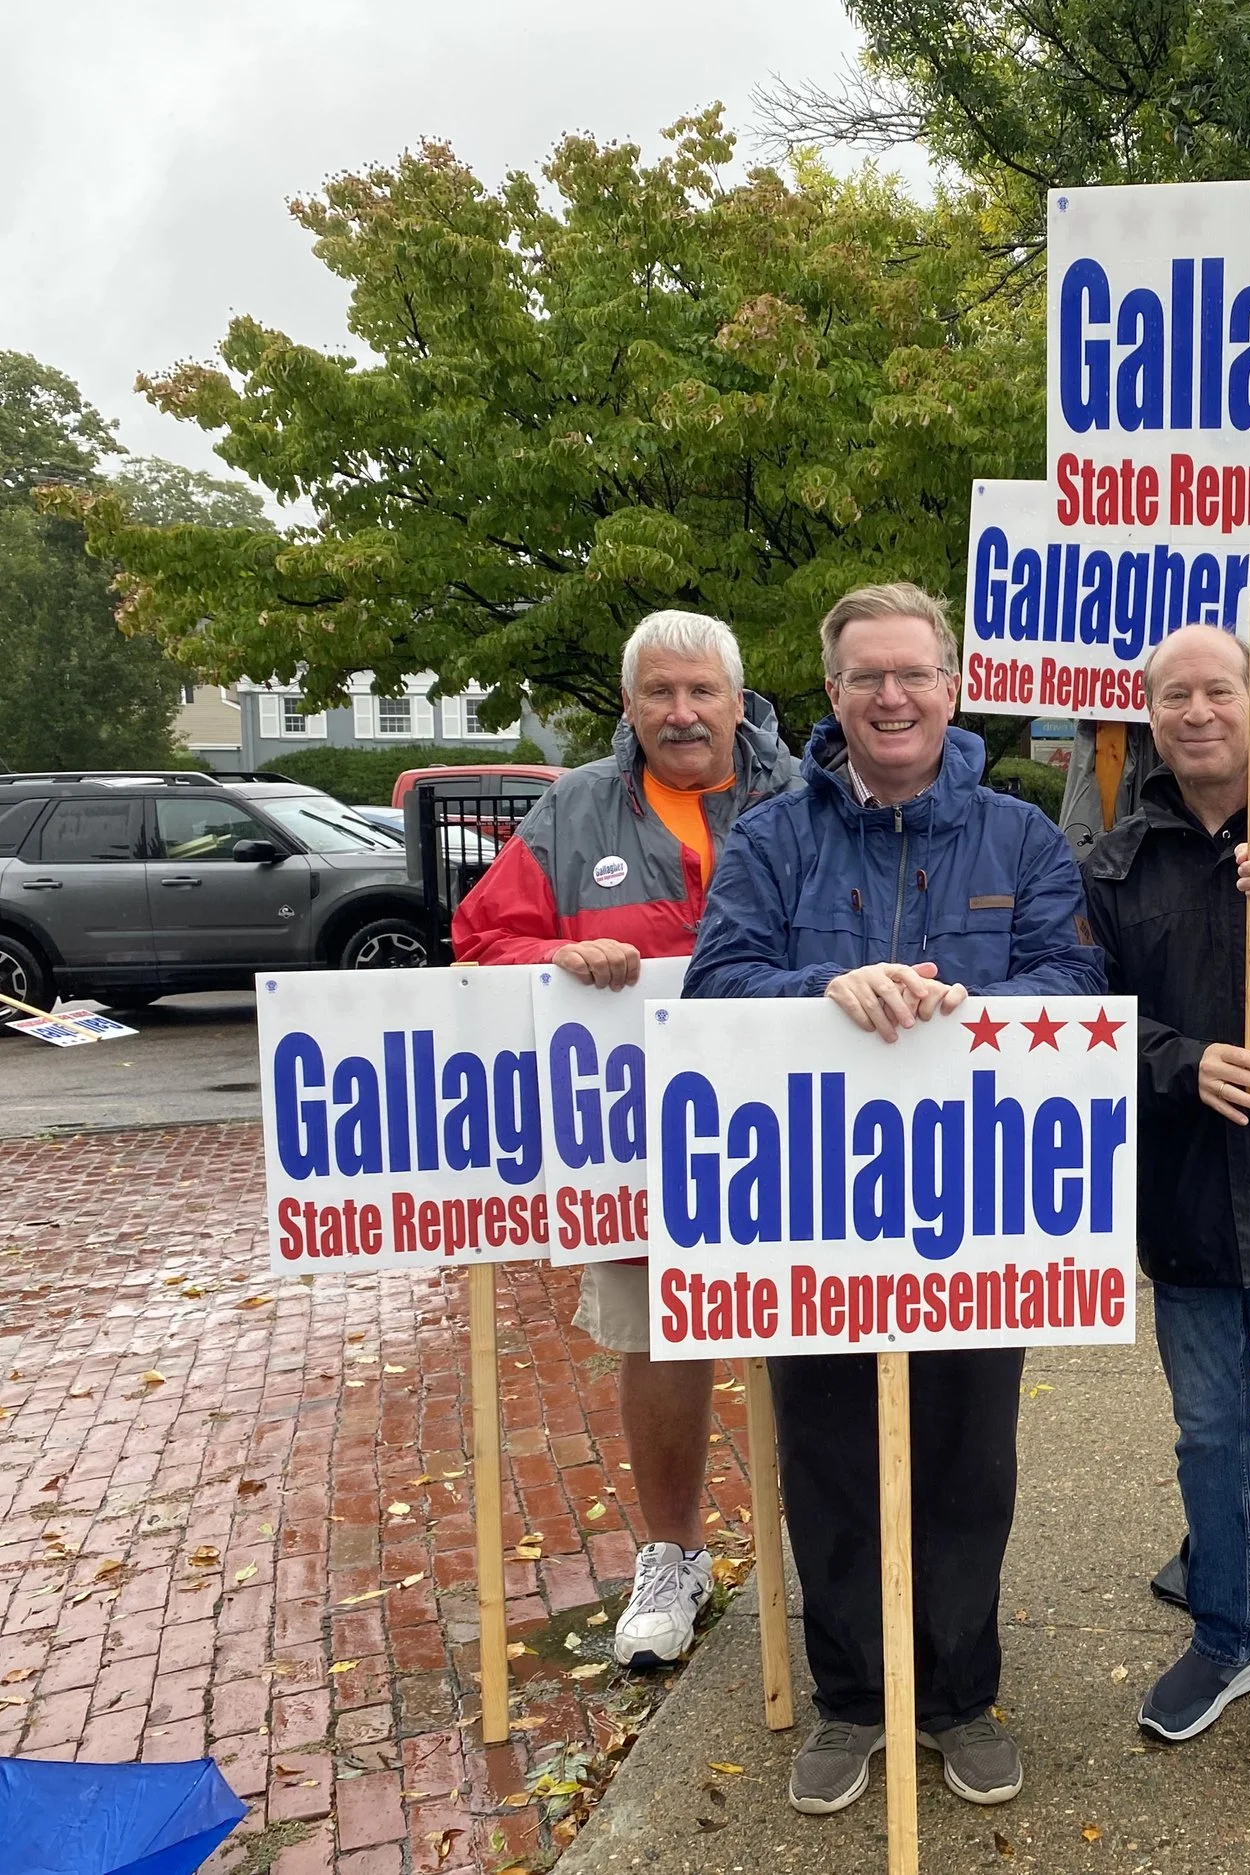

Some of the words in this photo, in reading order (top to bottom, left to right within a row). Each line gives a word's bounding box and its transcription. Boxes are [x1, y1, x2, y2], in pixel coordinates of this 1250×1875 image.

[1057, 453, 1159, 527] State
[973, 526, 1250, 661] Gallagher
[967, 652, 1034, 705] State
[1039, 657, 1147, 712] Represe
[30, 1017, 124, 1039] Gallgher
[273, 1029, 543, 1185] Gallag
[661, 1070, 1127, 1261] Gallagher
[278, 1197, 383, 1260] State
[392, 1191, 550, 1256] Represe
[556, 1185, 649, 1250] State
[660, 1267, 779, 1343] State
[791, 1256, 1125, 1343] Representative
